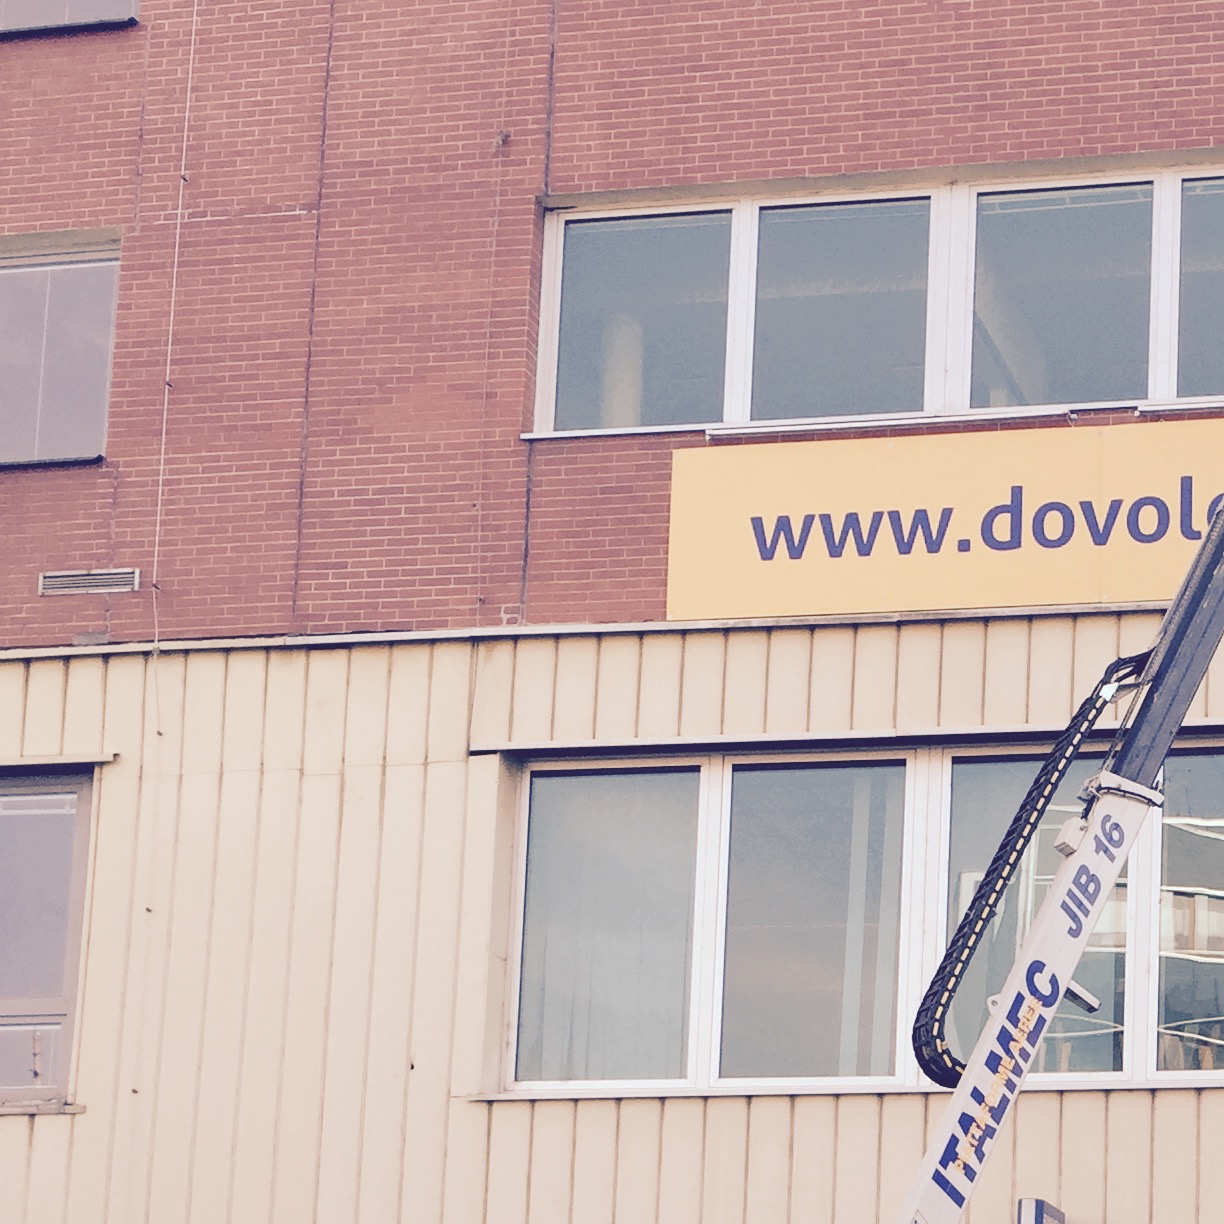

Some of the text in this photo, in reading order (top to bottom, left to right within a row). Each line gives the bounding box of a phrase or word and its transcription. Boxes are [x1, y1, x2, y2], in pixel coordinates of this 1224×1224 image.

[1060, 814, 1125, 939] JIB 16
[932, 960, 1060, 1209] ITALMEC
